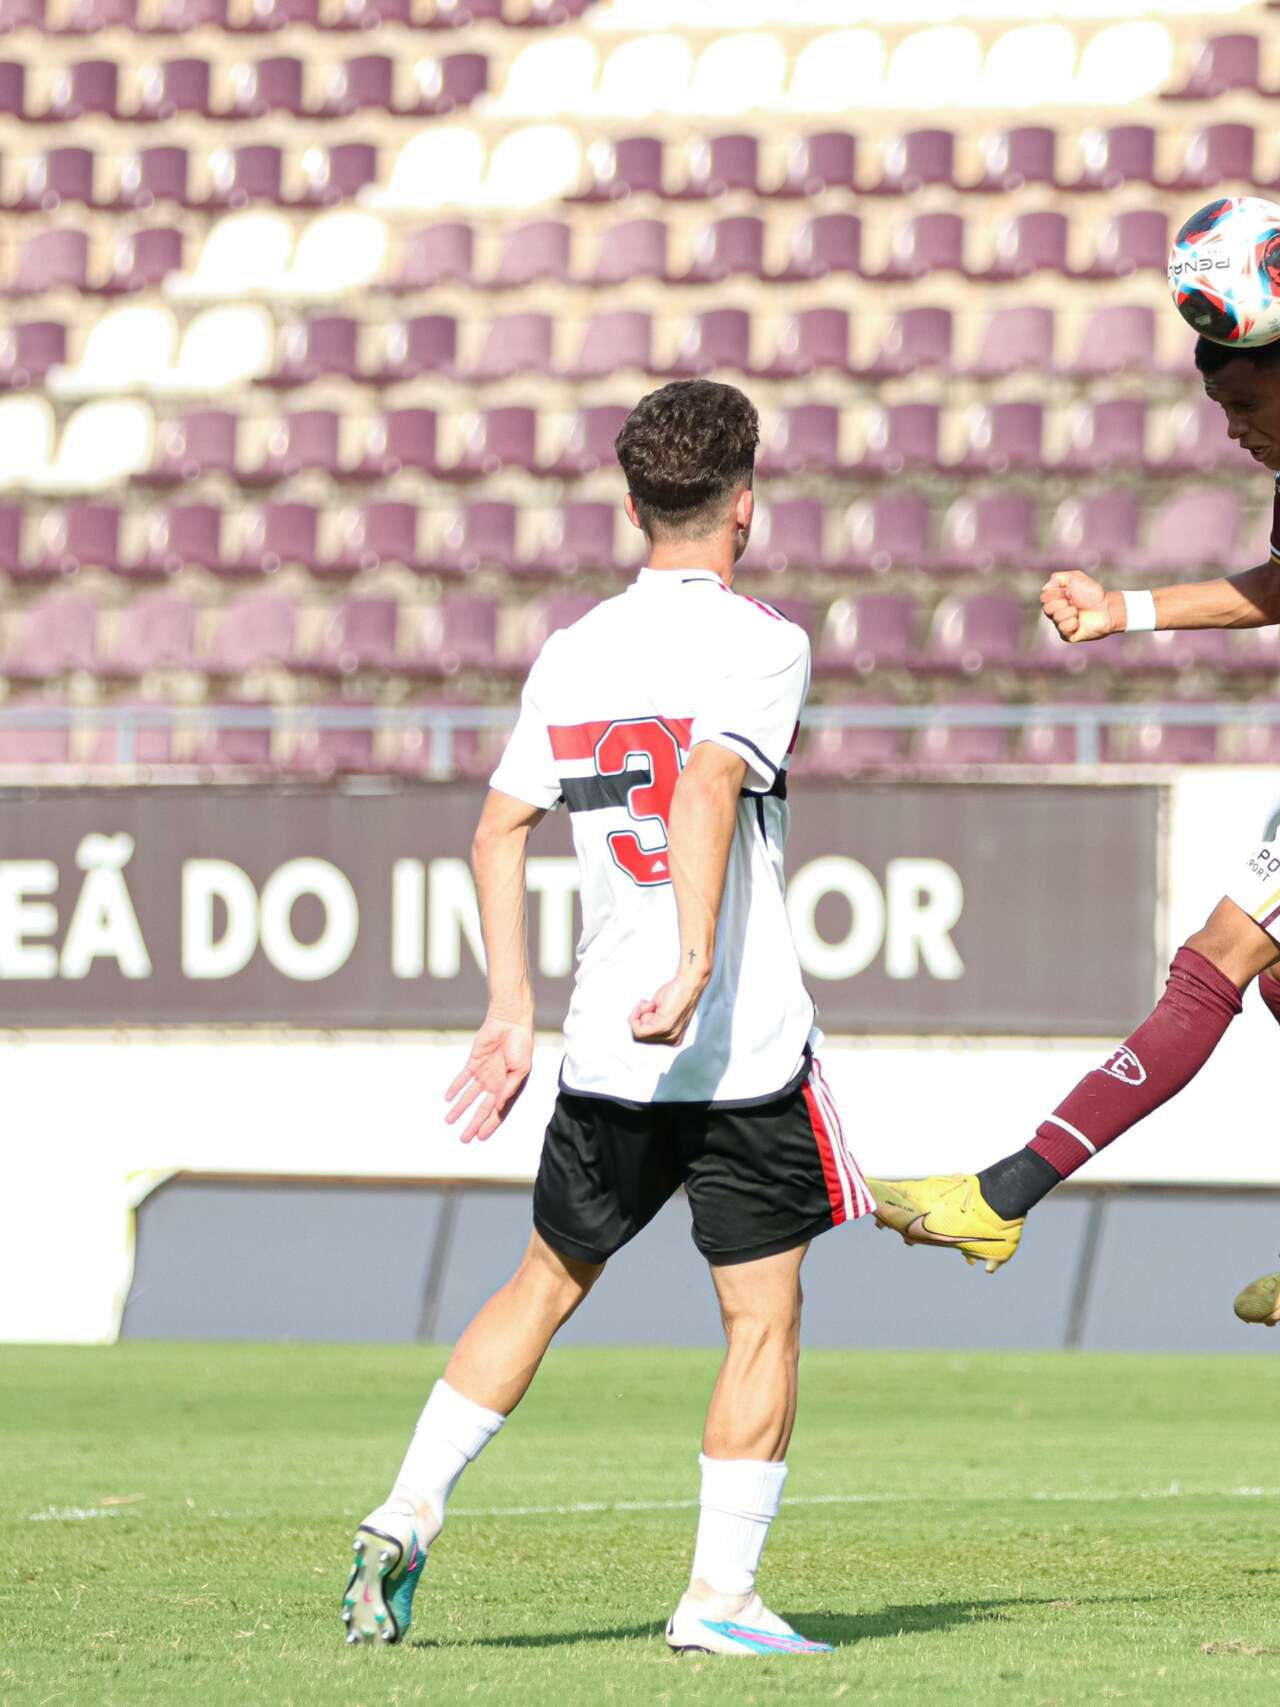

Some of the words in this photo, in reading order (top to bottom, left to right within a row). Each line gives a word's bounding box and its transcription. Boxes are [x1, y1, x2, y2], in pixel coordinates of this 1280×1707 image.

[593, 715, 688, 887] 3
[180, 857, 360, 981] DO
[390, 856, 965, 981] INTOR
